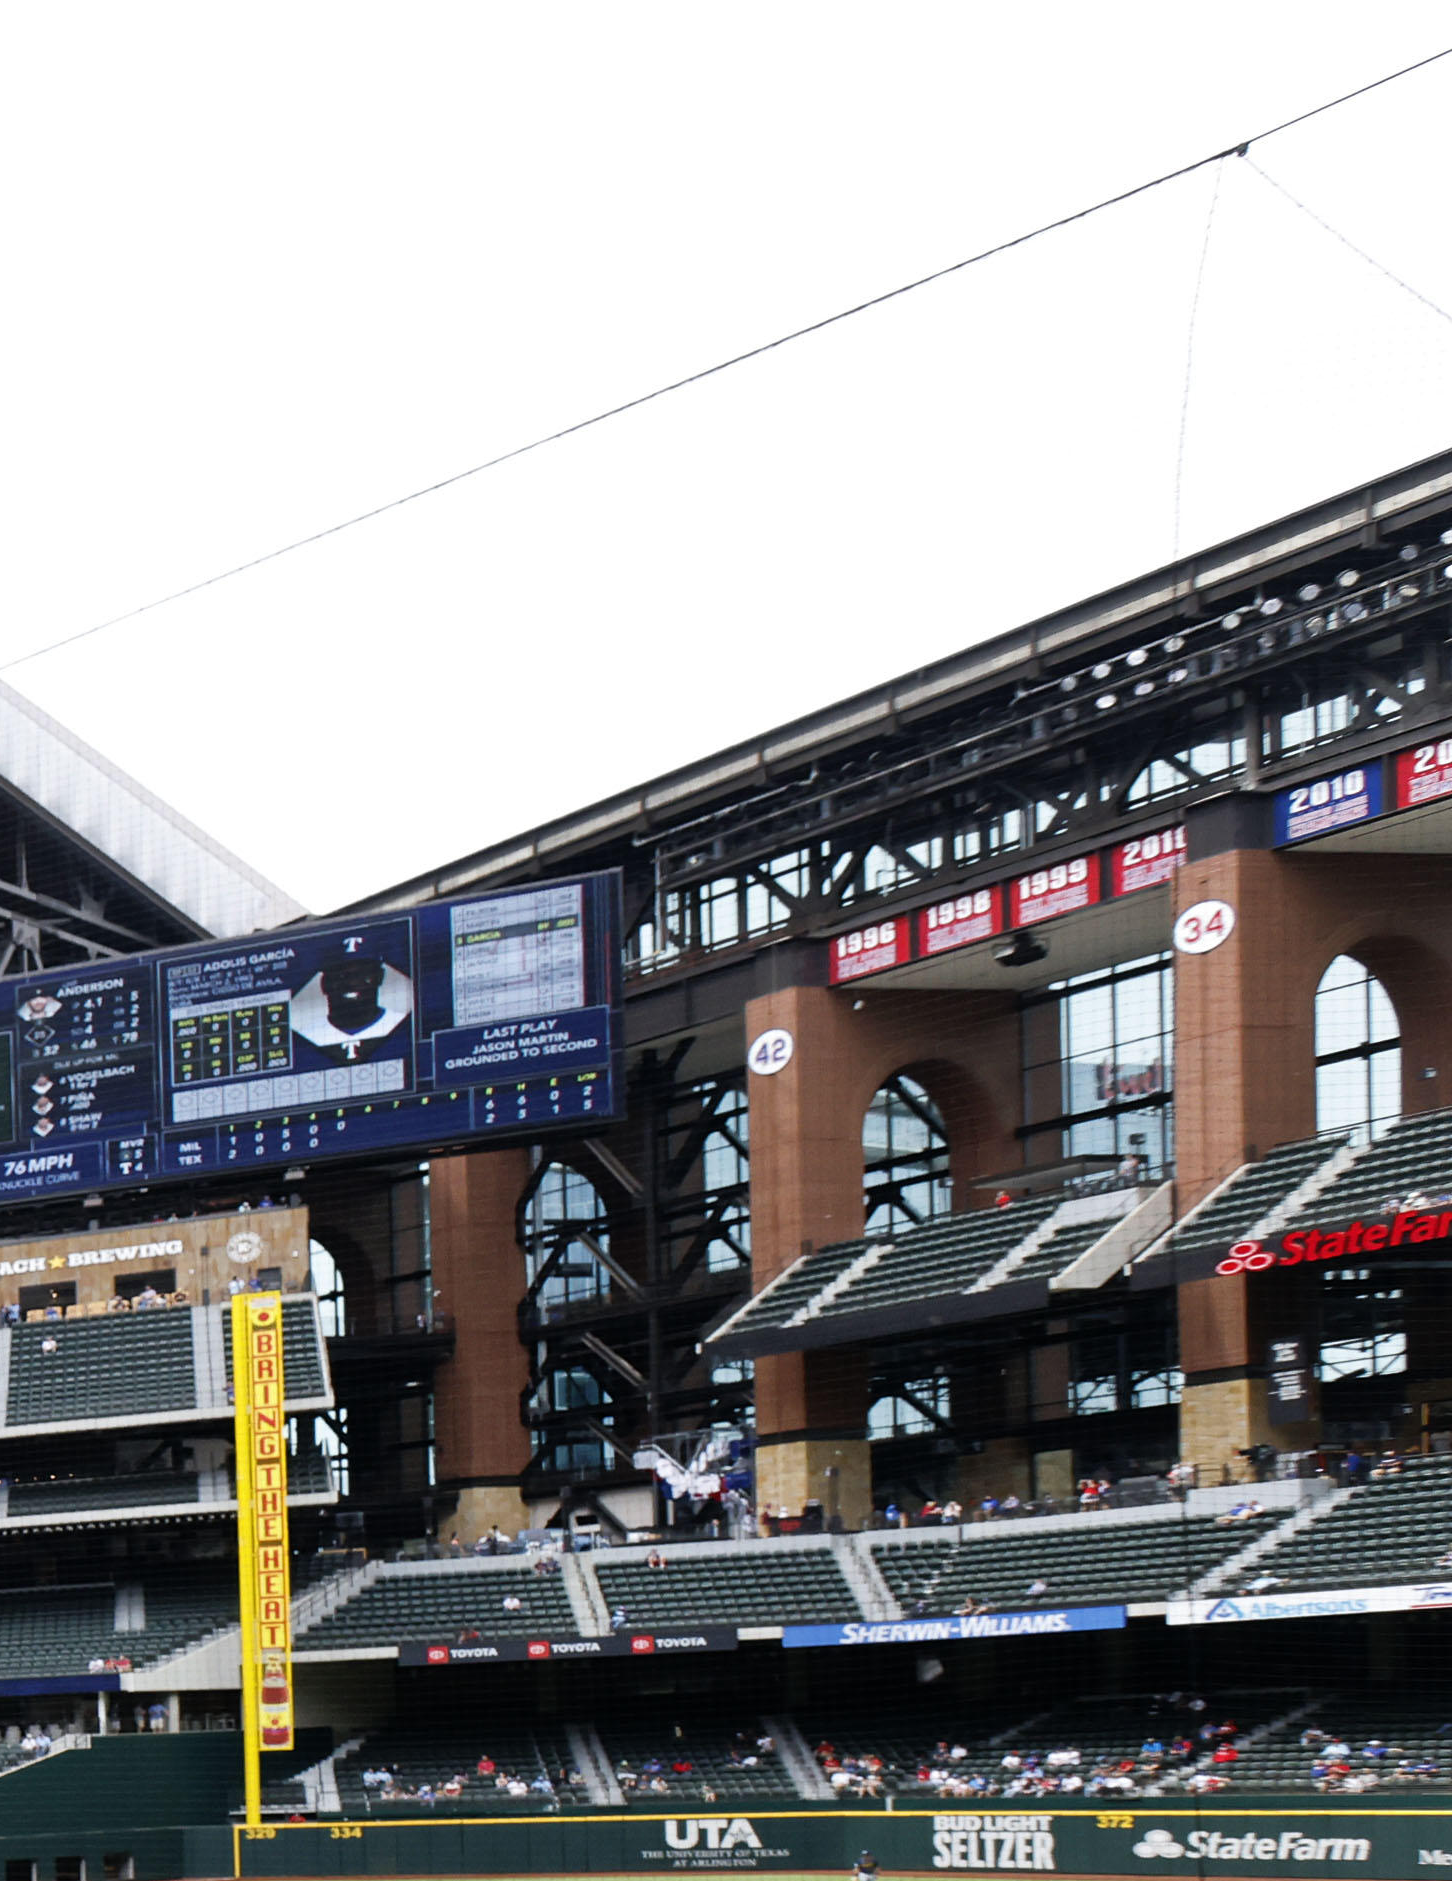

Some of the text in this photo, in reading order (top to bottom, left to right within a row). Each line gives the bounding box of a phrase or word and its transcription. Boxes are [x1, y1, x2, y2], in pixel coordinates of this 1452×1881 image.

[1289, 769, 1365, 815] 2010
[1019, 857, 1088, 900] 1999
[927, 889, 992, 929] 1998
[1184, 910, 1225, 944] 34
[837, 922, 896, 958] 1996
[203, 956, 246, 973] ADOLIS
[249, 946, 295, 965] GARCÍA
[57, 978, 124, 998] ANDERSON
[84, 1024, 93, 1035] 4
[483, 1019, 558, 1040] LAST PLAY
[445, 1038, 598, 1070] GROUNDED TO SECOND
[472, 1032, 570, 1055] JASON MARTIN
[755, 1038, 787, 1064] 42
[67, 1065, 135, 1083] VOGELBACH
[68, 1112, 102, 1126] SHAW
[179, 1085, 592, 1153] MIL 1 0 5 0 0 6 6 0 2
[229, 1124, 234, 1133] 1
[255, 1120, 262, 1129] 2
[282, 1116, 289, 1125] 3
[336, 1108, 344, 1117] 5
[364, 1105, 371, 1113] 6
[394, 1100, 400, 1109] 7
[421, 1096, 429, 1105] 8
[449, 1091, 457, 1100] 9
[178, 1099, 592, 1165] TEX 2 0 0 0 2 5 1 5
[46, 1171, 80, 1185] CURVE
[68, 1240, 183, 1267] BREWING
[256, 1333, 281, 1645] BRING THE HEAT
[1249, 1599, 1368, 1618] Albertsons
[450, 1647, 498, 1659] TOYOTA
[551, 1642, 601, 1654] TOYOTA
[656, 1636, 707, 1648] TOYOTA
[330, 1826, 362, 1839] 334
[665, 1818, 763, 1849] UTA
[933, 1815, 1053, 1831] BUD LIGHT
[1097, 1815, 1135, 1829] 372
[753, 1848, 790, 1857] TEXAS
[932, 1831, 1056, 1869] SELTZER
[1185, 1830, 1372, 1862] StateFarm
[673, 1858, 756, 1868] AT ARLINGTON
